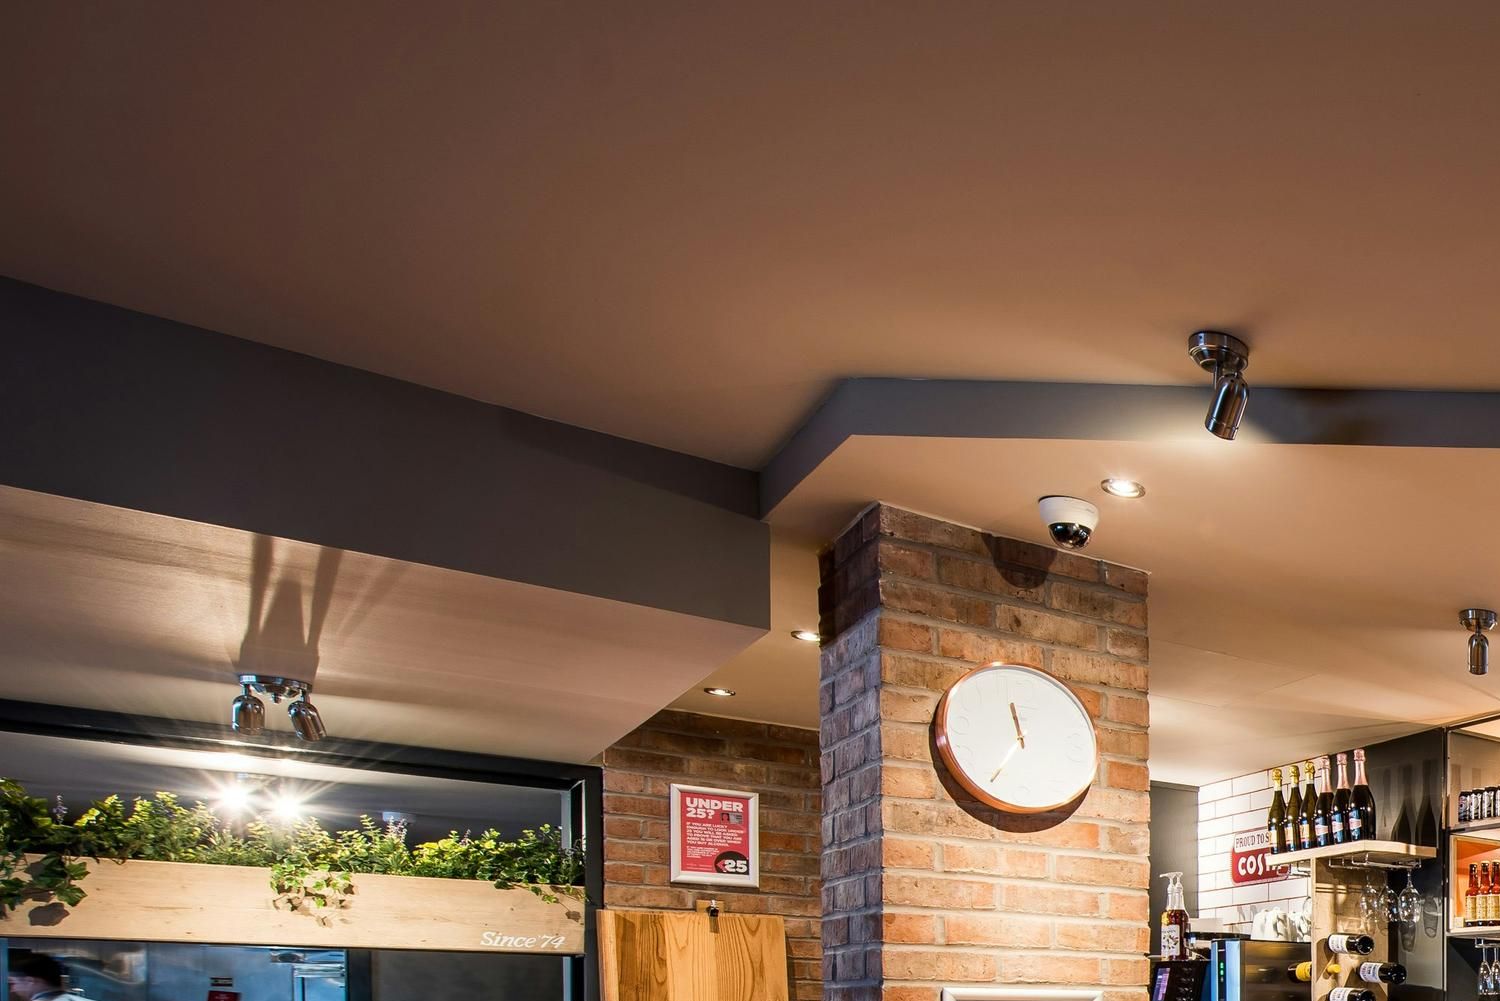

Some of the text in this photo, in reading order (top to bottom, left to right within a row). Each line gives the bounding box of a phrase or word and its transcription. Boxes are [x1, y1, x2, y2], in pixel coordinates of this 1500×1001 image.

[686, 797, 743, 812] UNDER
[686, 808, 715, 819] 25?
[1236, 835, 1255, 848] PROUD
[1257, 833, 1265, 845] TO
[724, 859, 748, 873] 25
[1238, 852, 1282, 876] COST
[480, 931, 537, 948] Since
